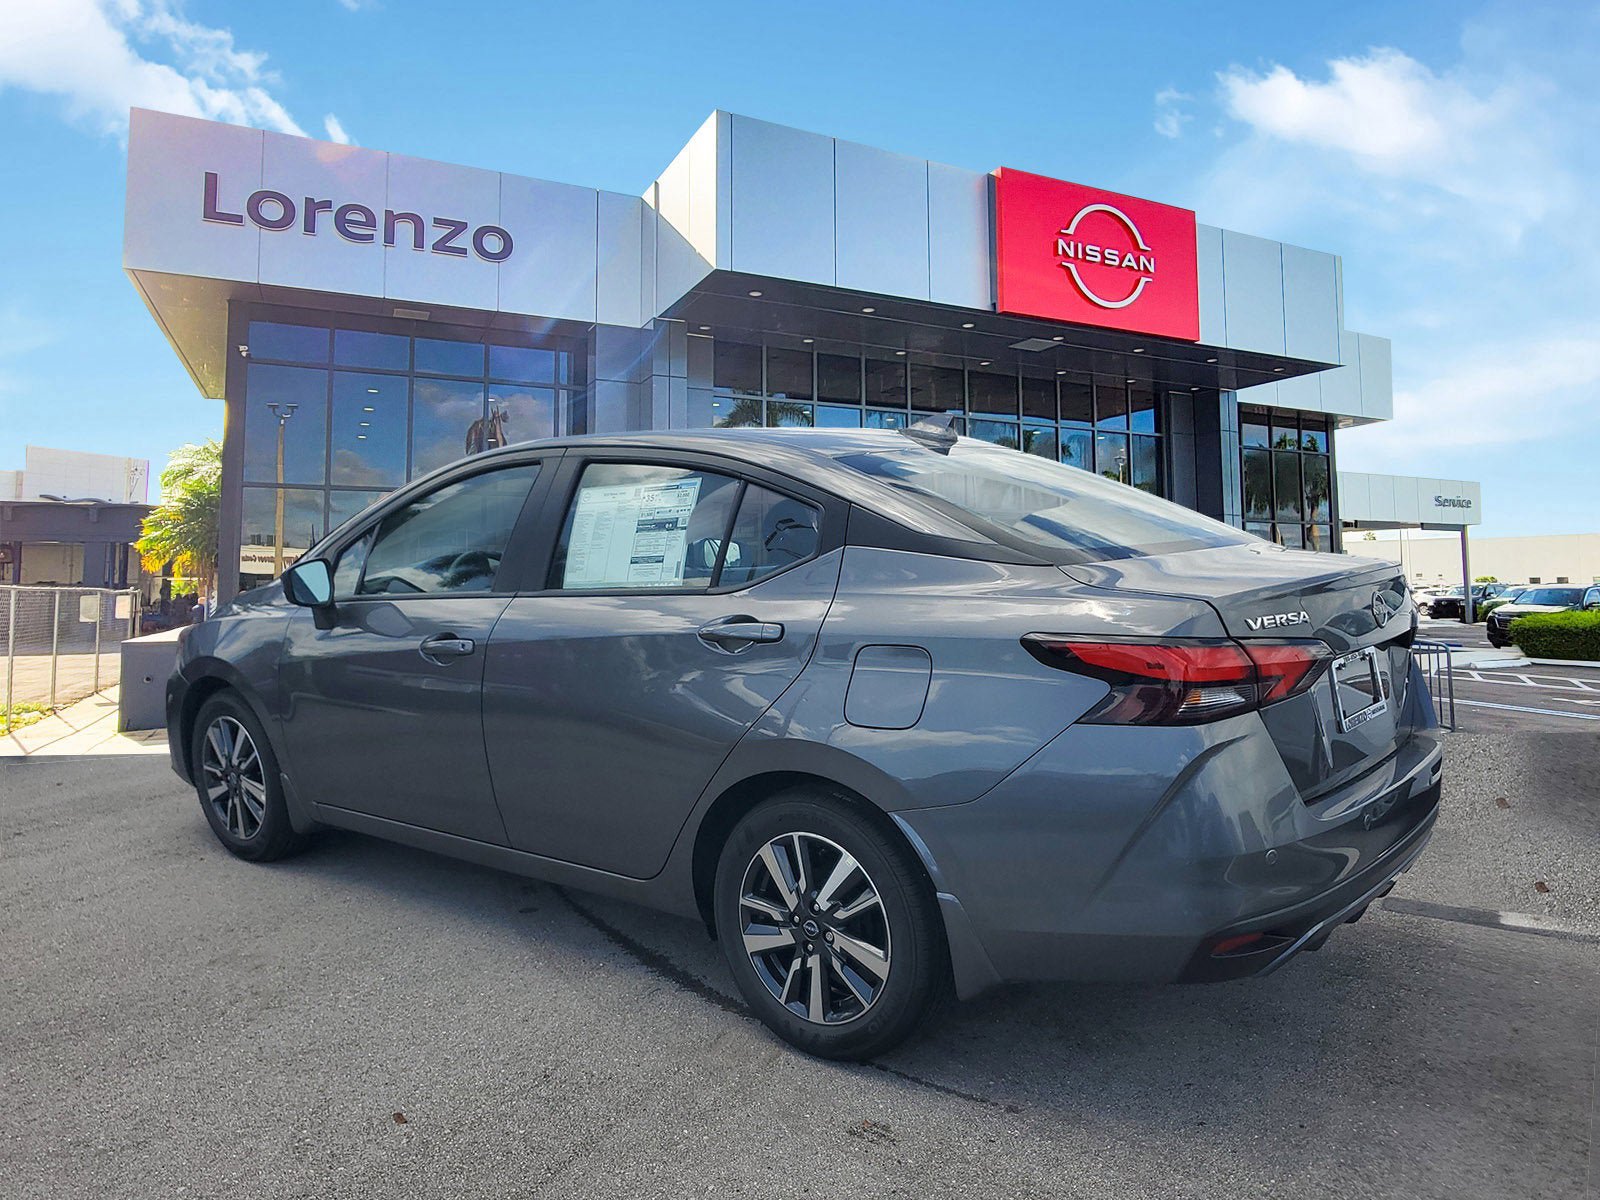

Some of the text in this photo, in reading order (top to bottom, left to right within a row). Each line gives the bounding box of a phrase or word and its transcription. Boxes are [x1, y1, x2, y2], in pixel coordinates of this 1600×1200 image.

[203, 171, 515, 263] Lorenzo
[1057, 238, 1155, 273] NISSAN
[1434, 495, 1472, 508] Service
[1244, 611, 1310, 631] VERSA
